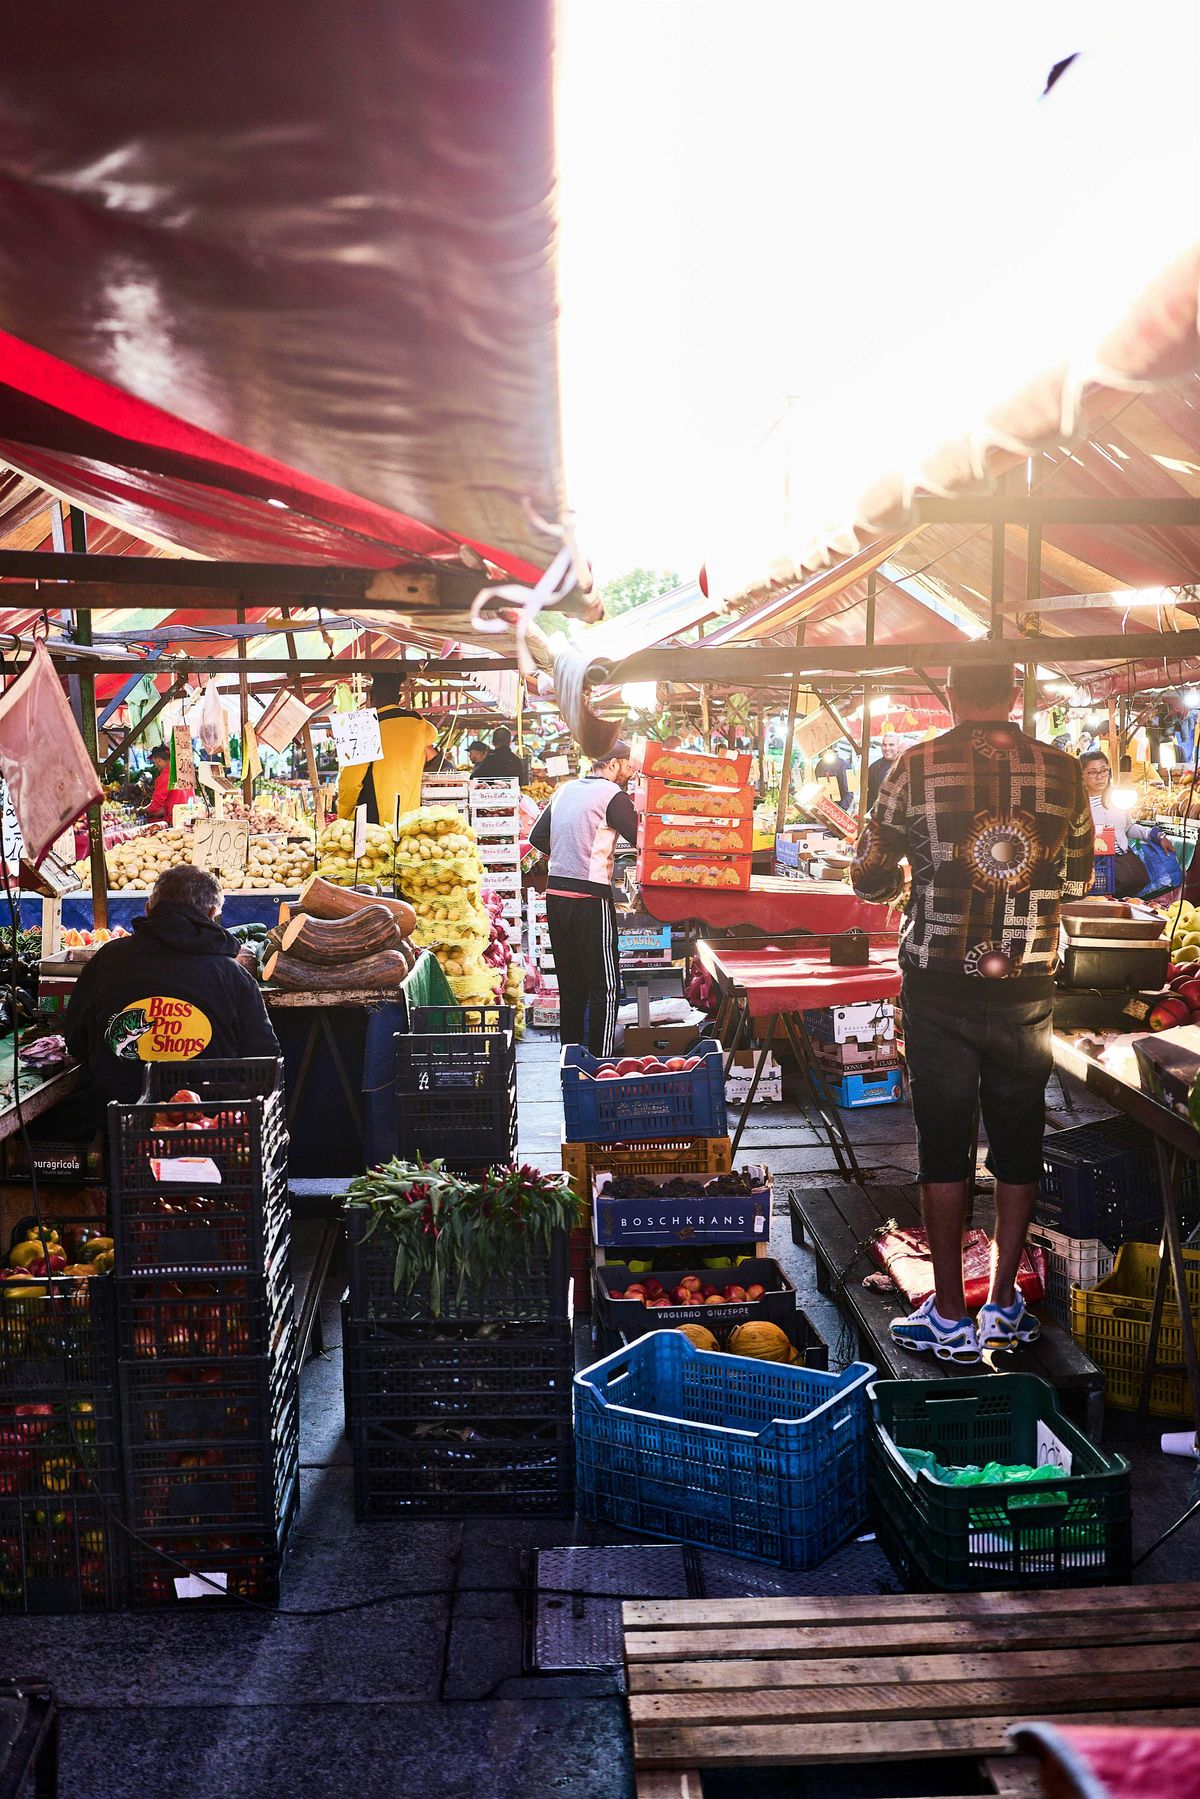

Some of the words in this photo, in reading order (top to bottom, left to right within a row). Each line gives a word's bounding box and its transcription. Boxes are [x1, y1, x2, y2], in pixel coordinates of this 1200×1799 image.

[148, 997, 192, 1017] Bass
[151, 1017, 182, 1035] Pro
[151, 1034, 205, 1056] Shops
[621, 1216, 745, 1227] BOSCHKRANS
[657, 1310, 701, 1319] VAGLIANO
[707, 1307, 749, 1317] GIUSEPPE
